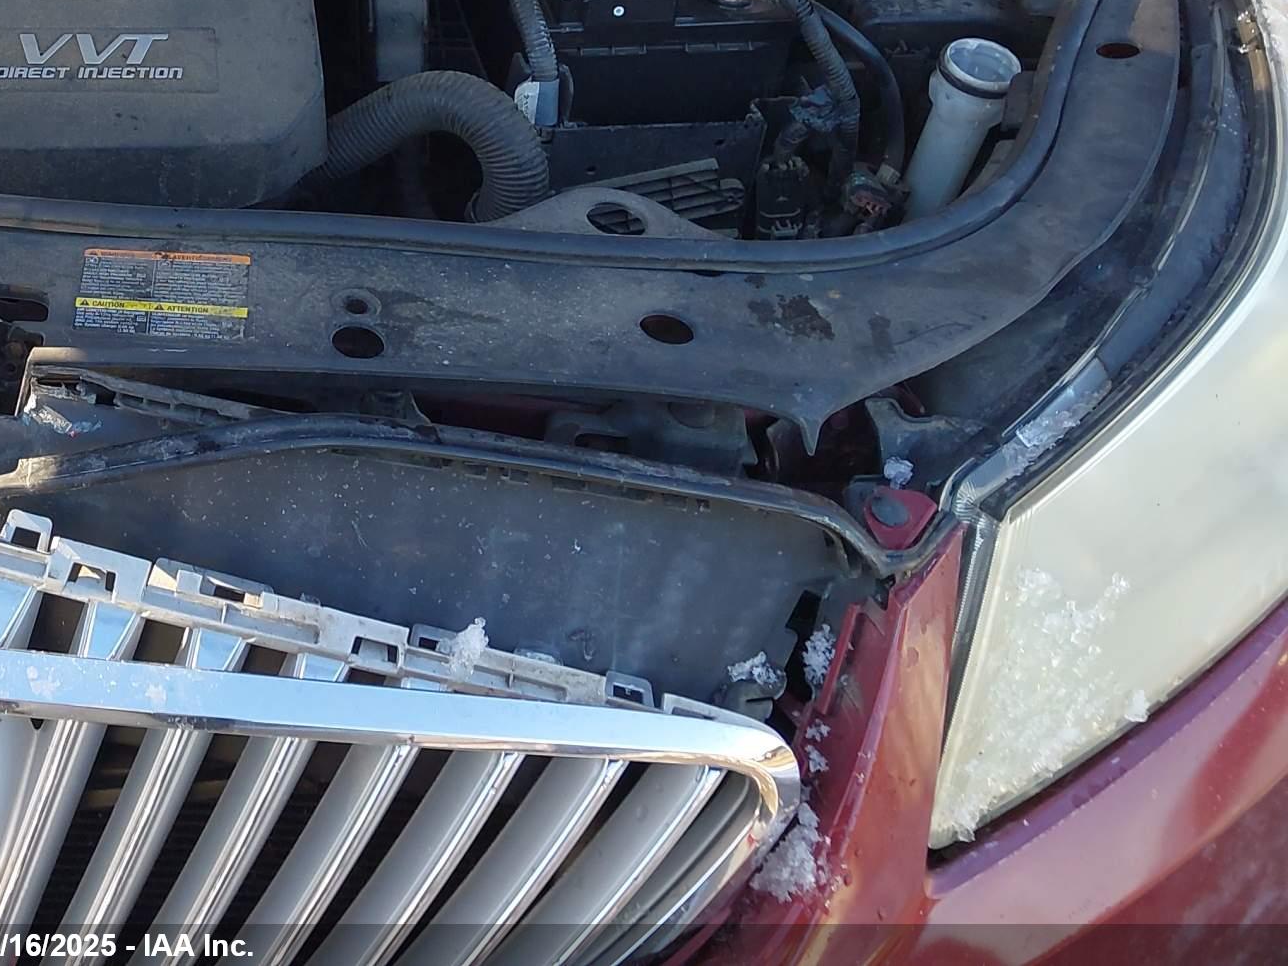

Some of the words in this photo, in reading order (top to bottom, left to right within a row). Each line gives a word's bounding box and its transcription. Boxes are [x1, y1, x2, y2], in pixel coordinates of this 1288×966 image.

[18, 33, 169, 65] VVT
[77, 66, 183, 80] INJECTION
[92, 300, 125, 308] CAUTION
[166, 305, 209, 314] ATTENTION
